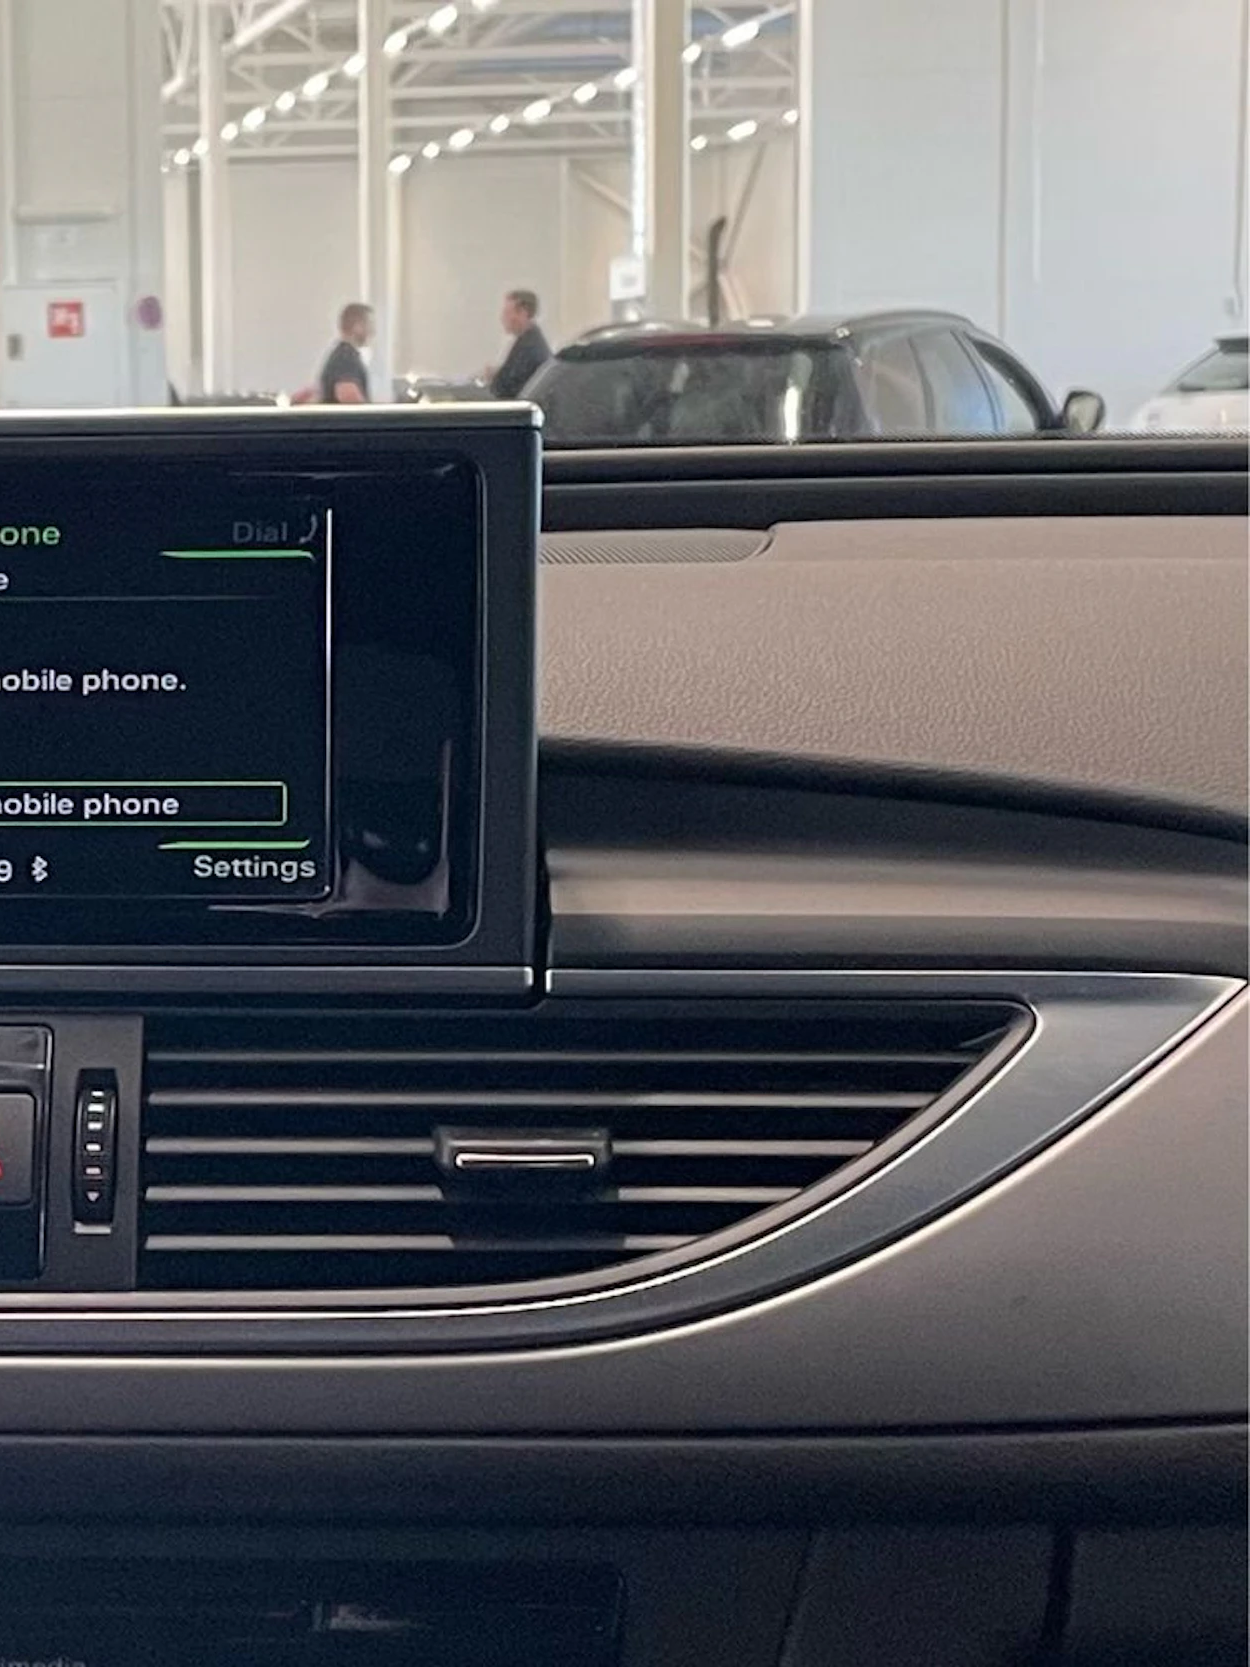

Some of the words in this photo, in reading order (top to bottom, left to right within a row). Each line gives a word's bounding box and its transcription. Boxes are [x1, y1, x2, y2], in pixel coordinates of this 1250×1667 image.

[232, 521, 288, 543] Dial
[82, 668, 187, 696] phone.
[83, 792, 180, 822] phone
[193, 854, 316, 883] Settings
